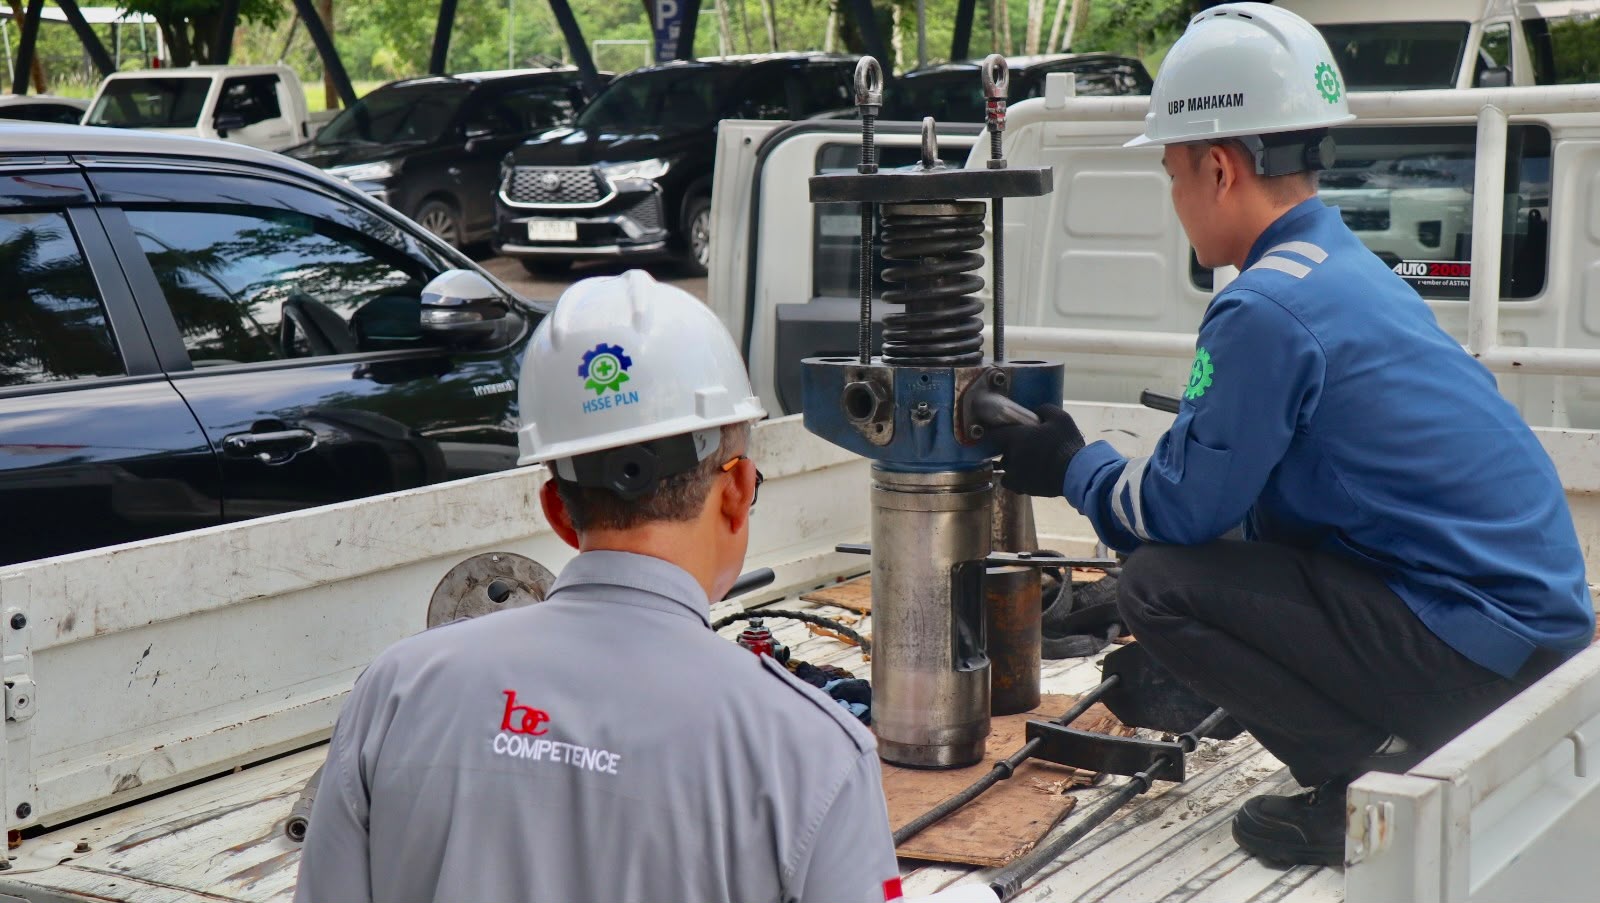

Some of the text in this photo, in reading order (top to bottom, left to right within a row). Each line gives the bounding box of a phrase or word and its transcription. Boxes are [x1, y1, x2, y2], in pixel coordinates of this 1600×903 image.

[656, 0, 677, 29] P
[1168, 93, 1243, 115] UBP MAHAKAM
[1391, 263, 1427, 275] AUTO
[583, 391, 639, 413] HSSE PLN
[493, 732, 621, 775] COMPETENCE
